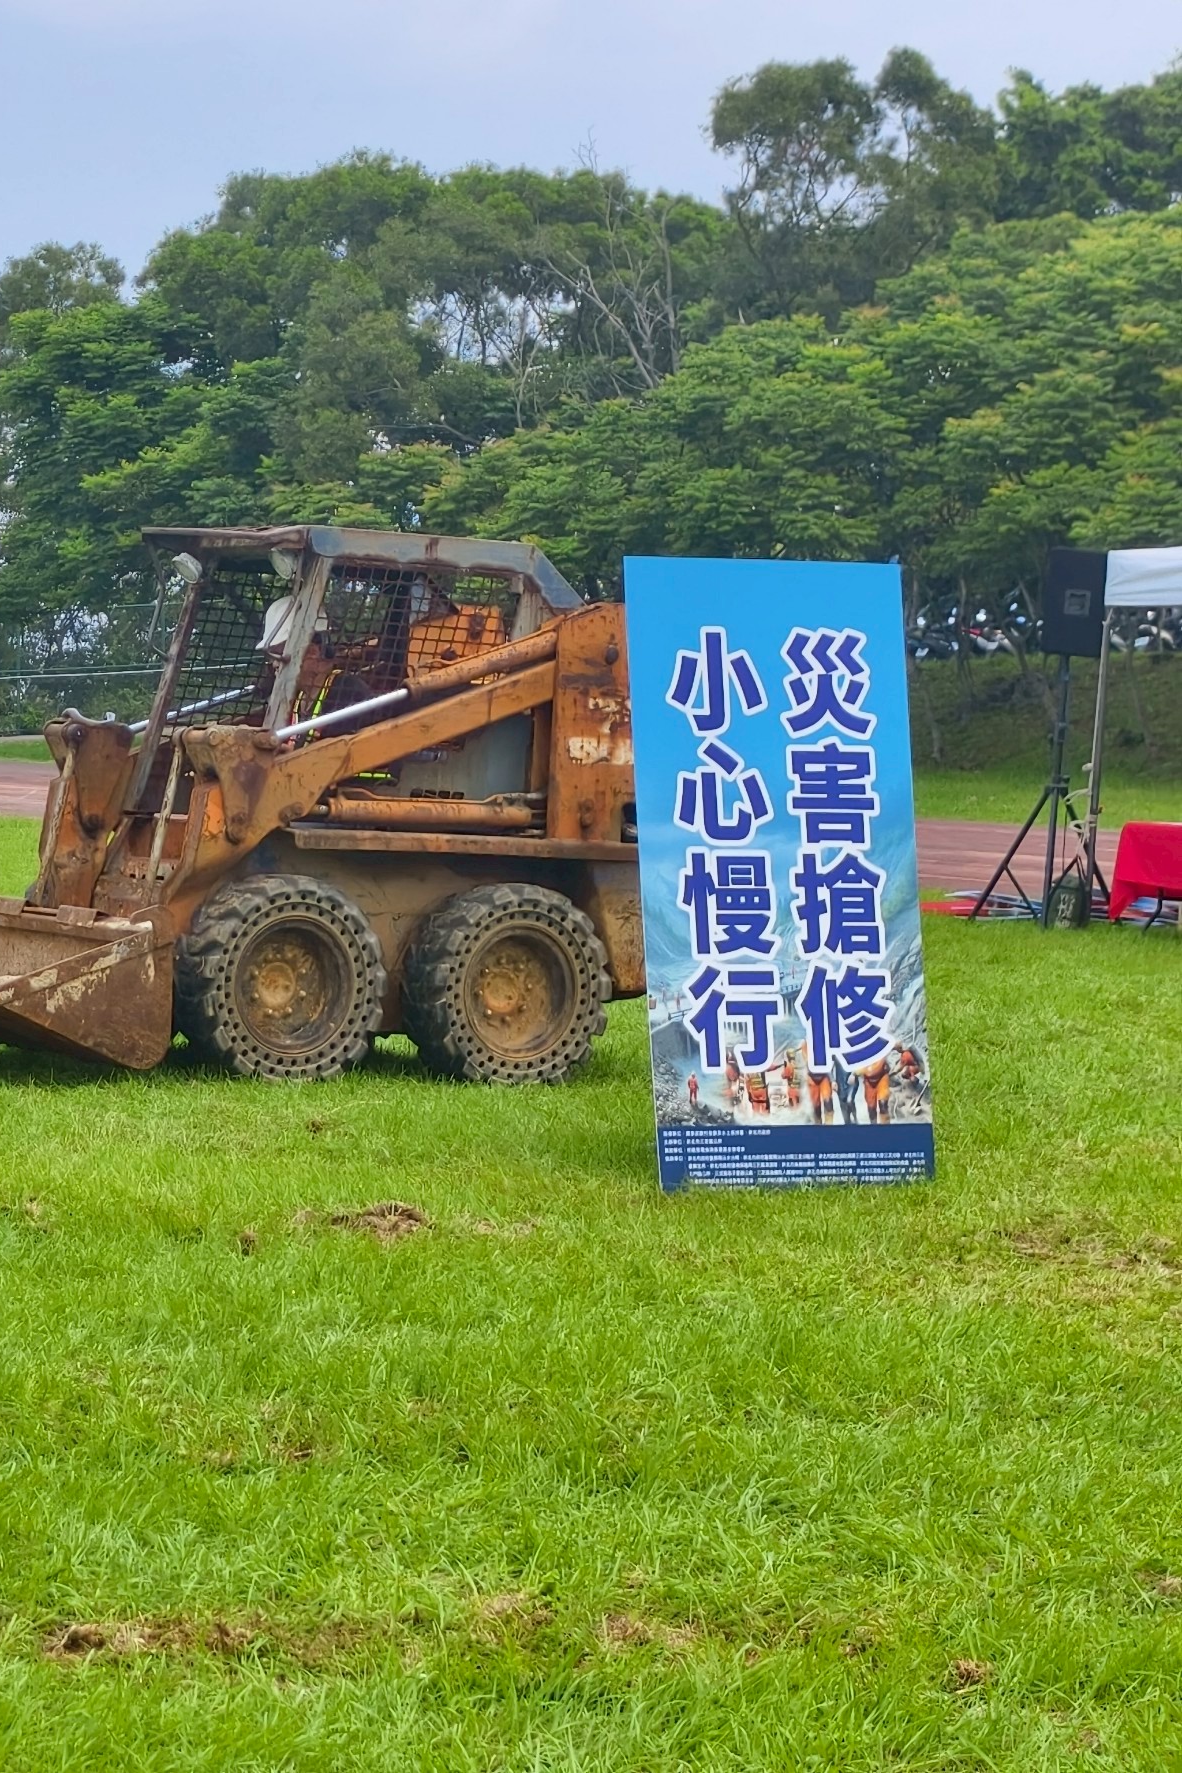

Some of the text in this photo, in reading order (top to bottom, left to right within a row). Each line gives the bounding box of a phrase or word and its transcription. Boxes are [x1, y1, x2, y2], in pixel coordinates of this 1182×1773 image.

[667, 627, 784, 1073] 小心慢行
[782, 628, 895, 1072] 災害搶修
